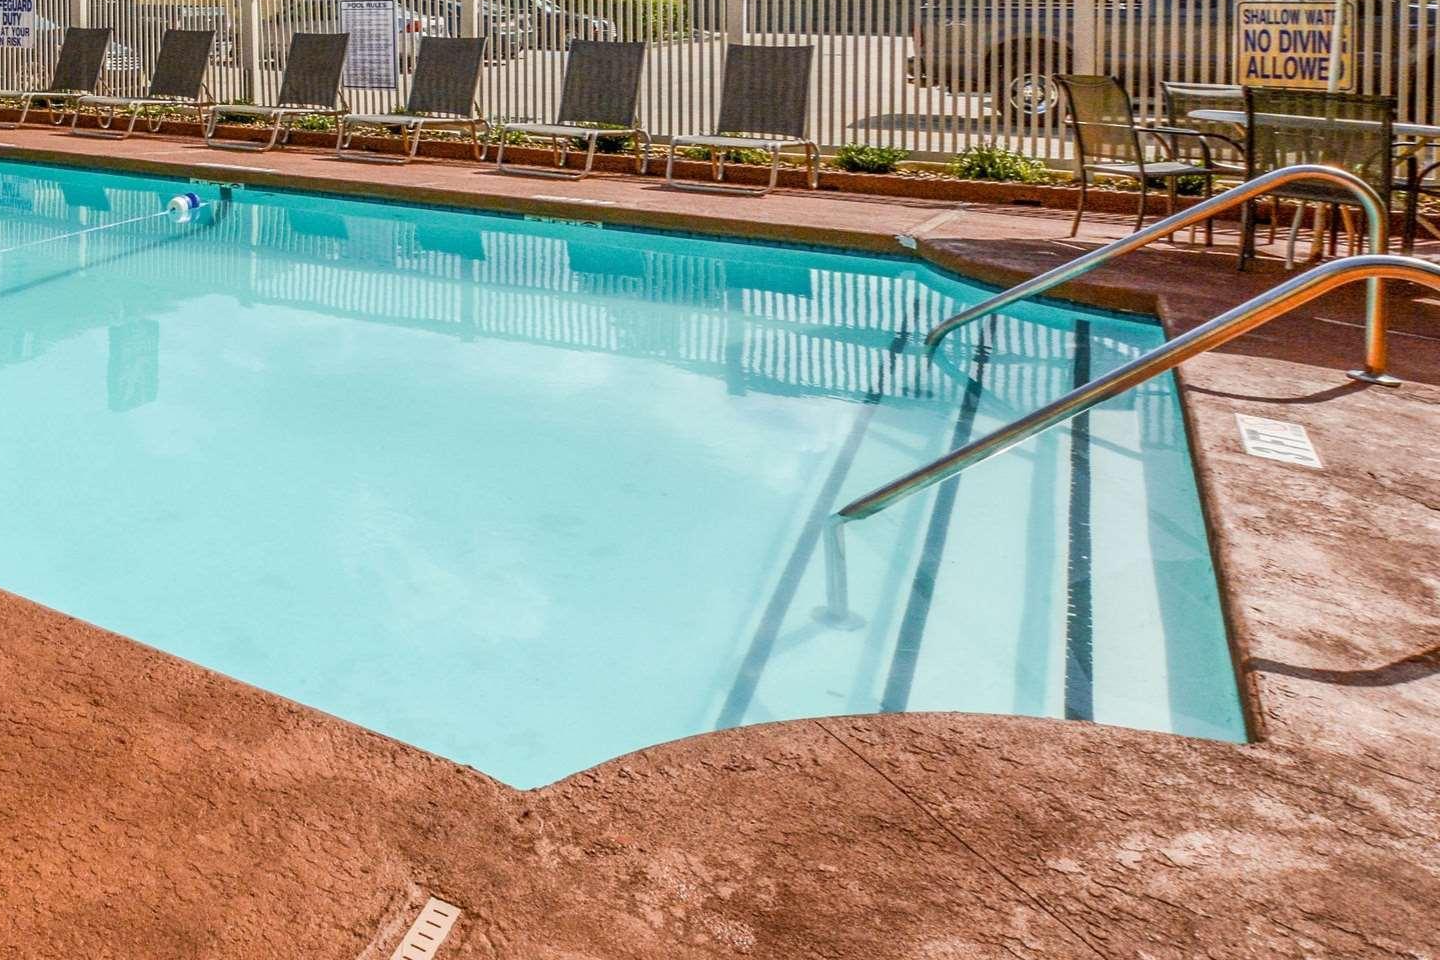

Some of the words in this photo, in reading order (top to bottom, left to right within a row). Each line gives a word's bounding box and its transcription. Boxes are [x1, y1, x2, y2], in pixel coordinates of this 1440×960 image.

[3, 12, 22, 25] DUTY
[1243, 8, 1299, 25] SHALLOW
[1305, 9, 1347, 26] WAT
[1, 26, 8, 36] AT
[12, 27, 30, 37] YOUR
[6, 37, 22, 47] RISK
[1244, 29, 1271, 53] NO
[1279, 30, 1347, 54] DIVIN
